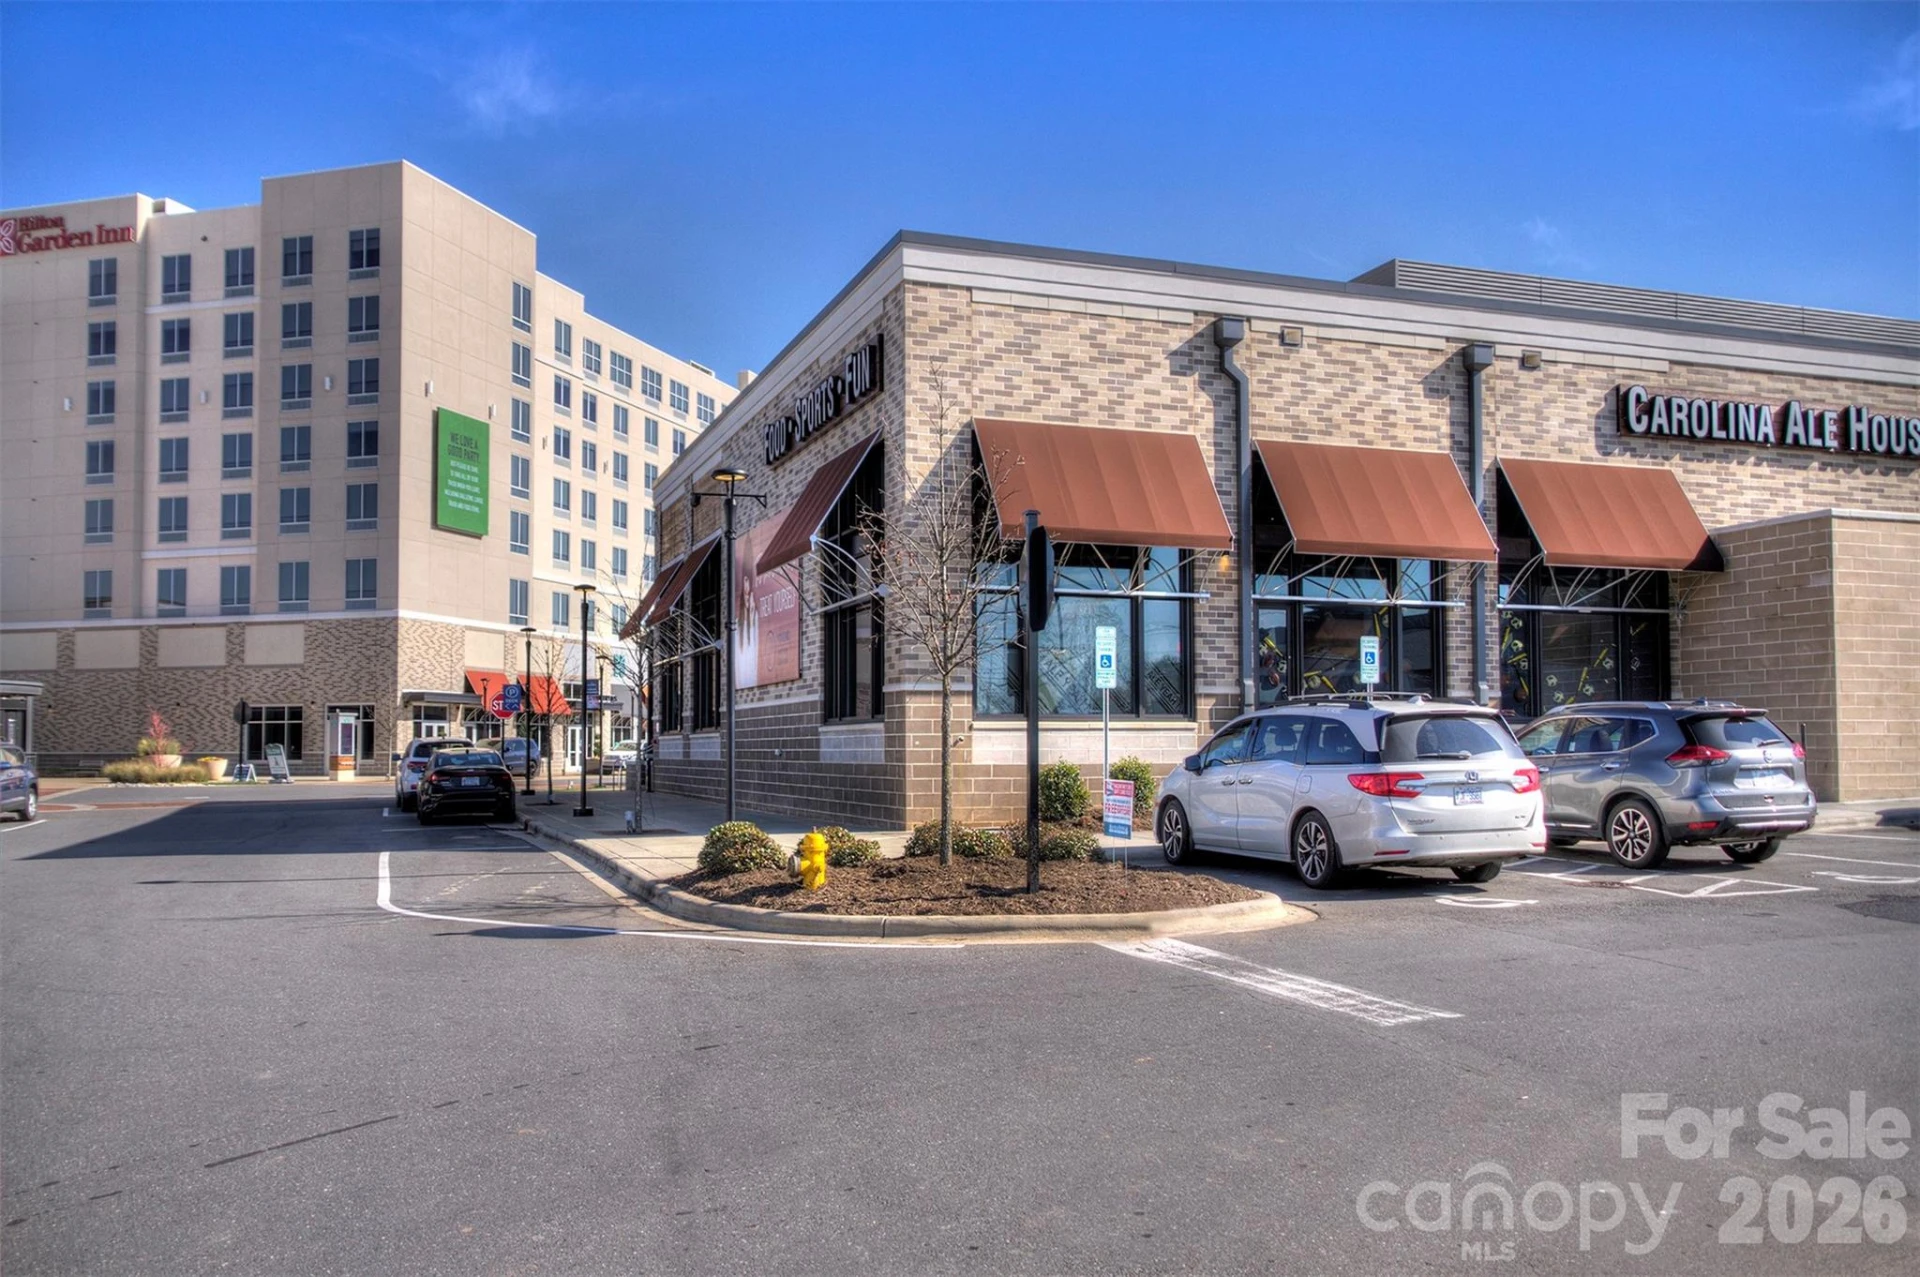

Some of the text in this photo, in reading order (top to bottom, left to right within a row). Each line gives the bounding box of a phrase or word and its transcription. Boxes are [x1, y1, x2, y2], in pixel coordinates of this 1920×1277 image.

[17, 223, 134, 254] Garden Inn
[18, 215, 64, 231] Hilton
[764, 345, 872, 464] FOOD SPORTS FUN
[1627, 384, 1775, 444] CAROLINA
[1785, 400, 1838, 448] ALE
